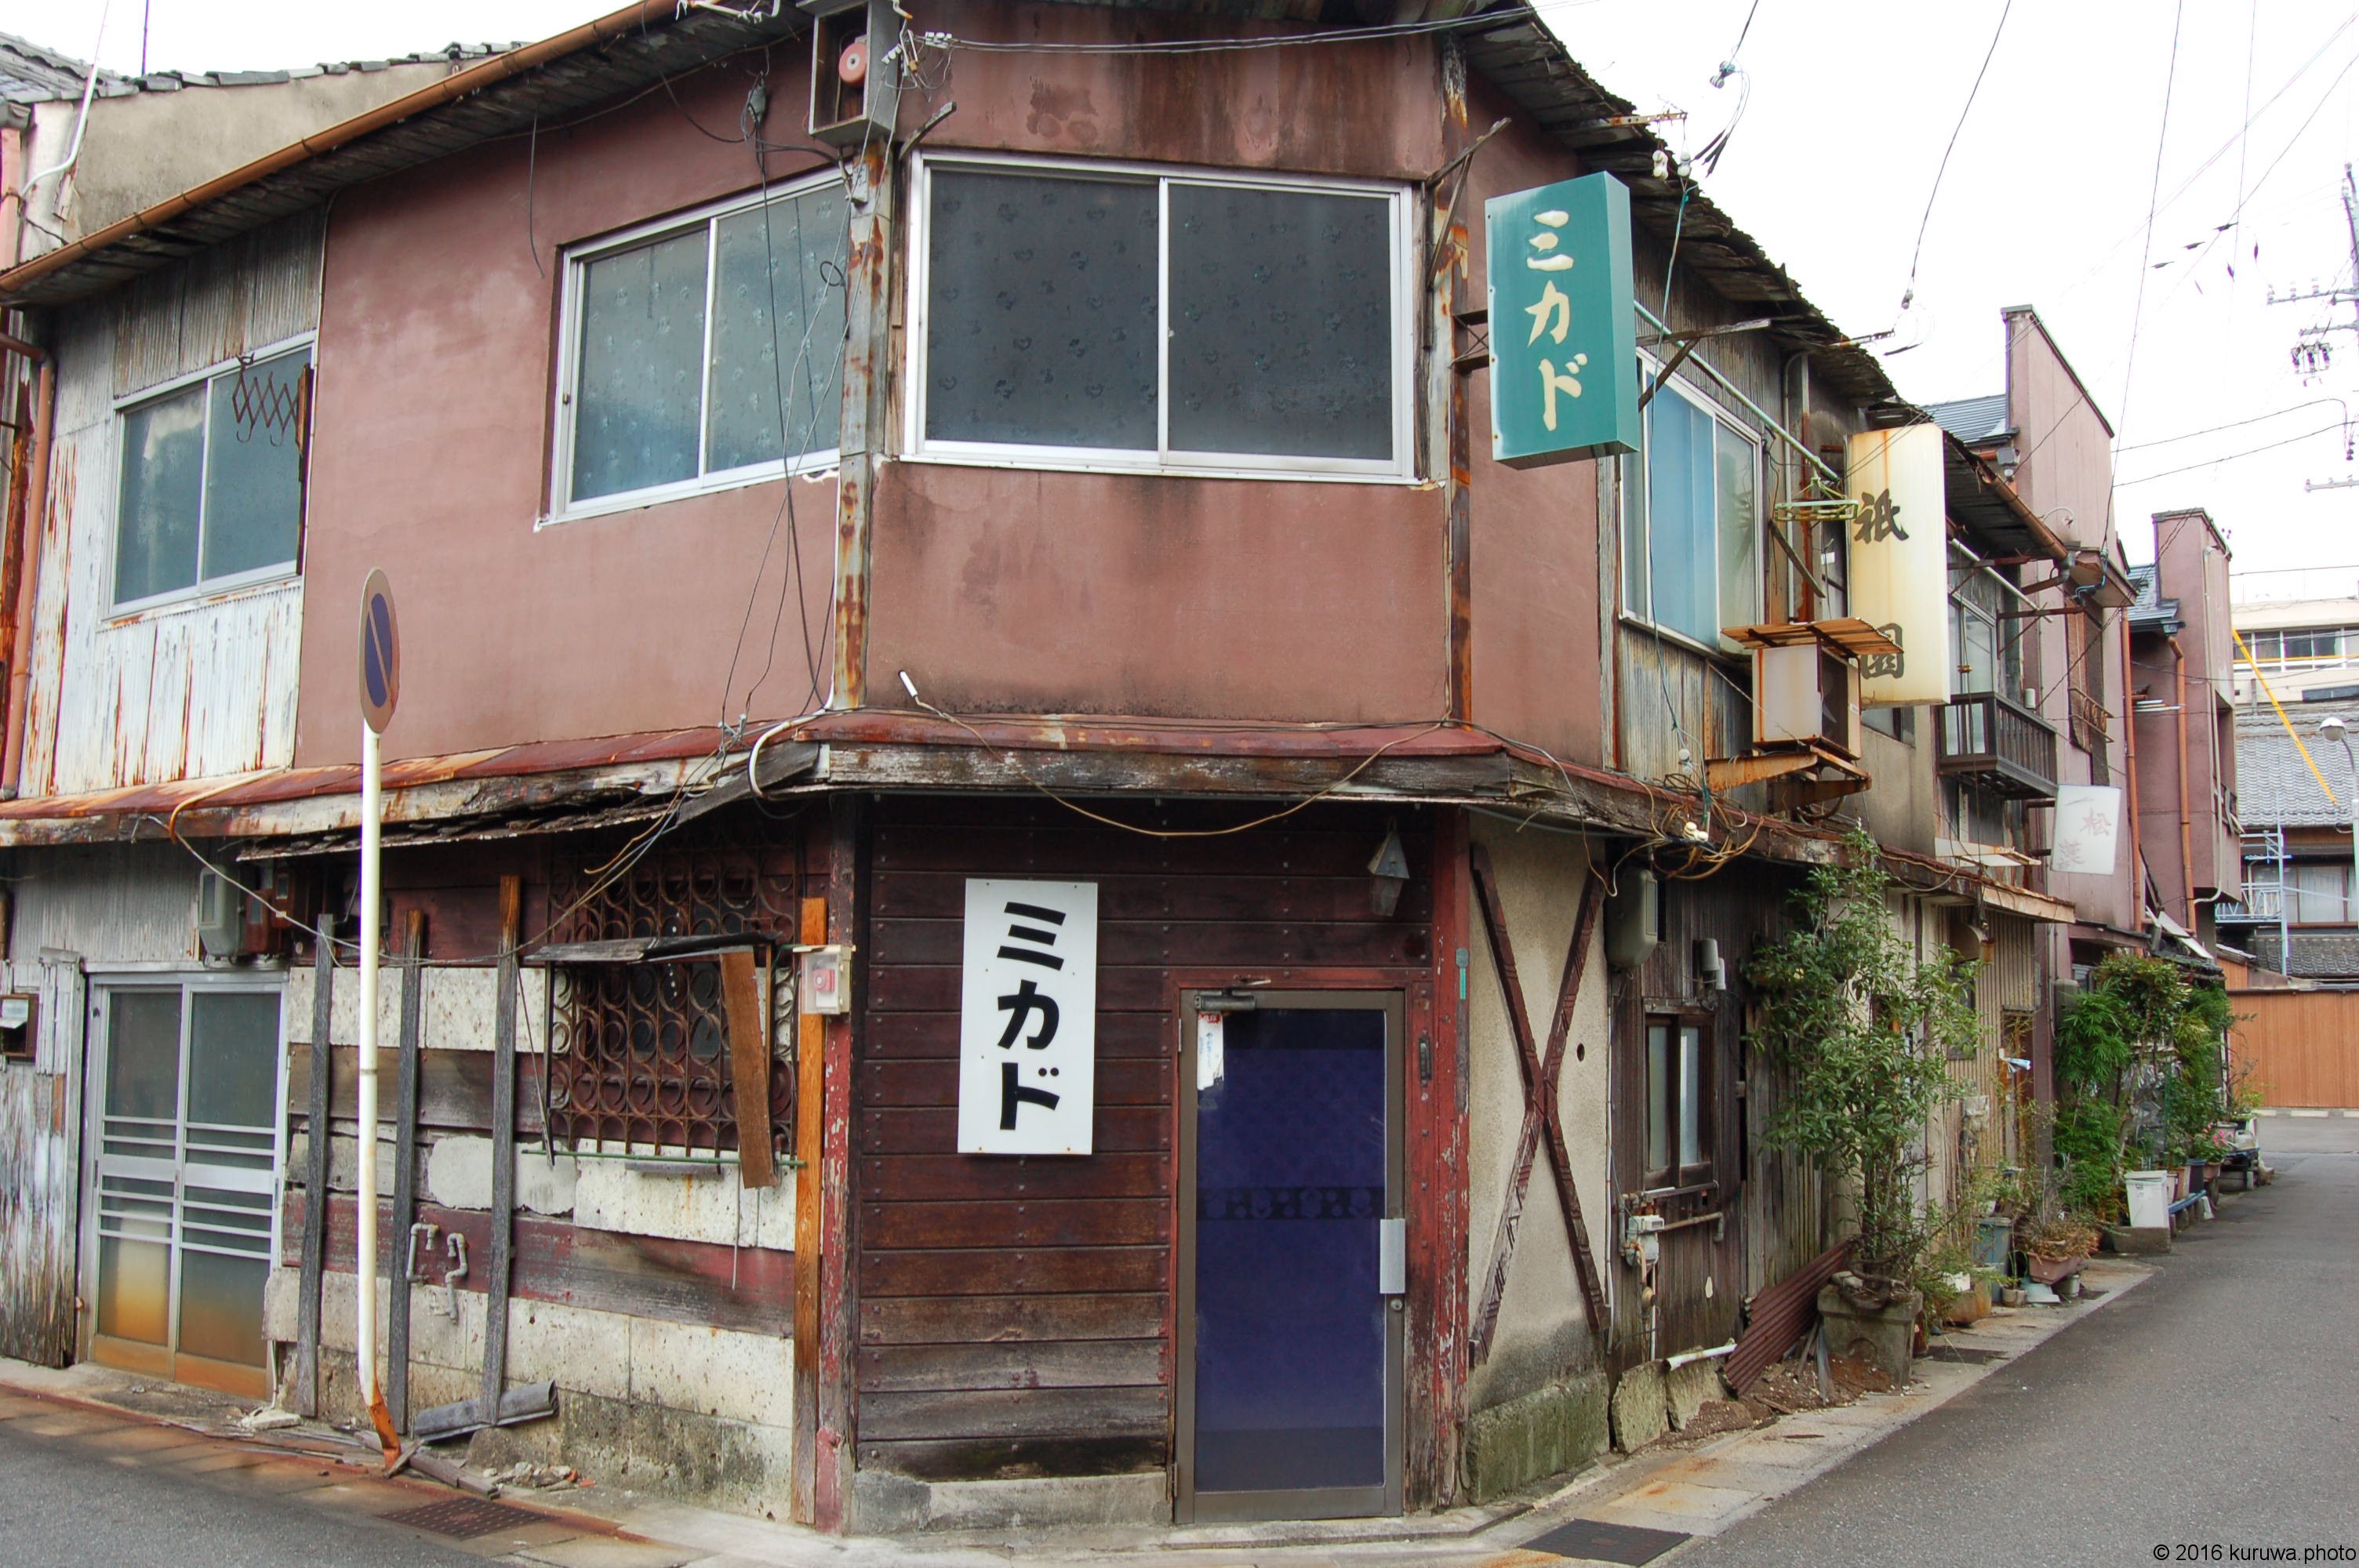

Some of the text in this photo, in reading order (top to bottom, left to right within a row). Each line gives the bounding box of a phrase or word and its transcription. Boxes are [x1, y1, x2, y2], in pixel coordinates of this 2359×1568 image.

[1525, 209, 1588, 432] ミカド
[996, 901, 1067, 1131] ミカド
